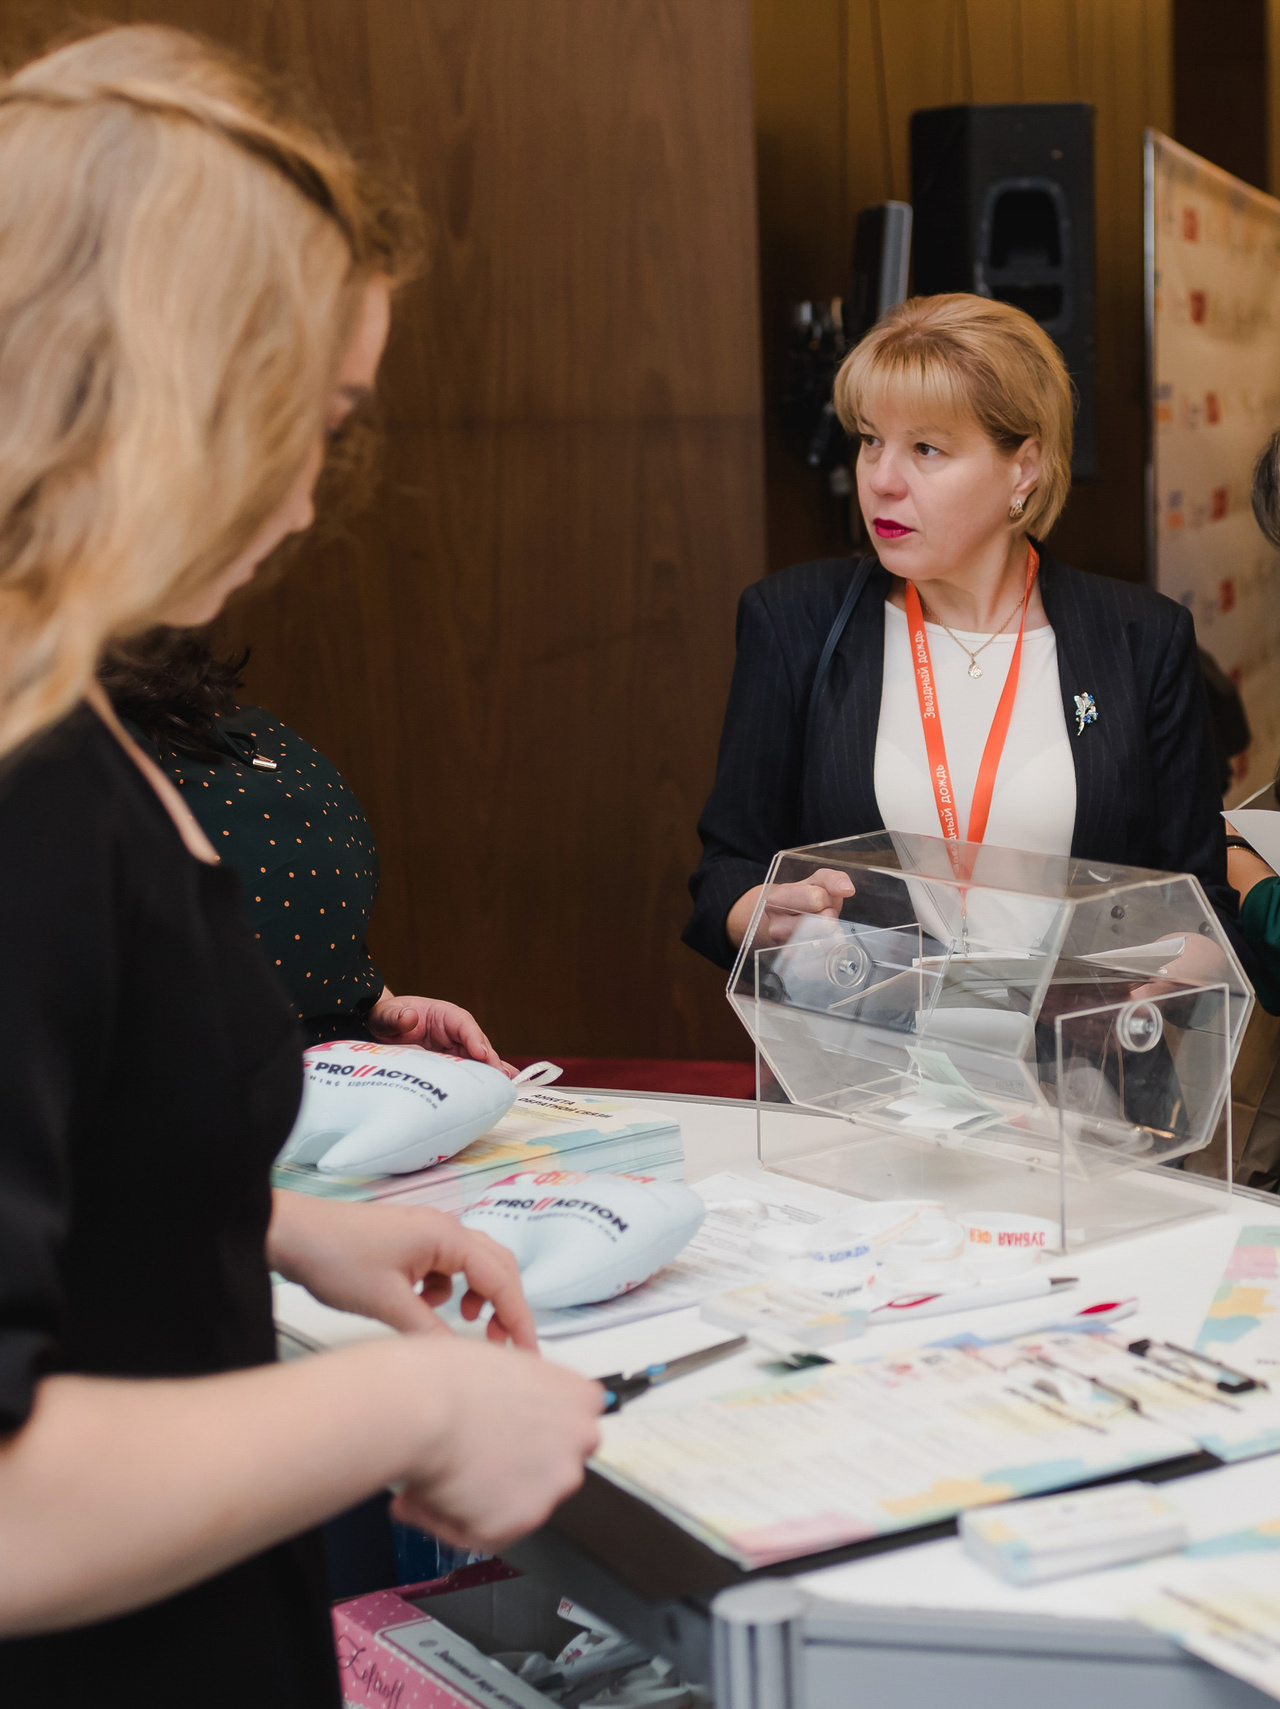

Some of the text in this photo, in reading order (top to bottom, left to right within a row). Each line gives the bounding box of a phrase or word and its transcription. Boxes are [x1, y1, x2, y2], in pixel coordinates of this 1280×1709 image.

[915, 630, 936, 719] Звездный дождь
[936, 764, 952, 804] дождь
[998, 1231, 1046, 1248] ЗУБНАЯ
